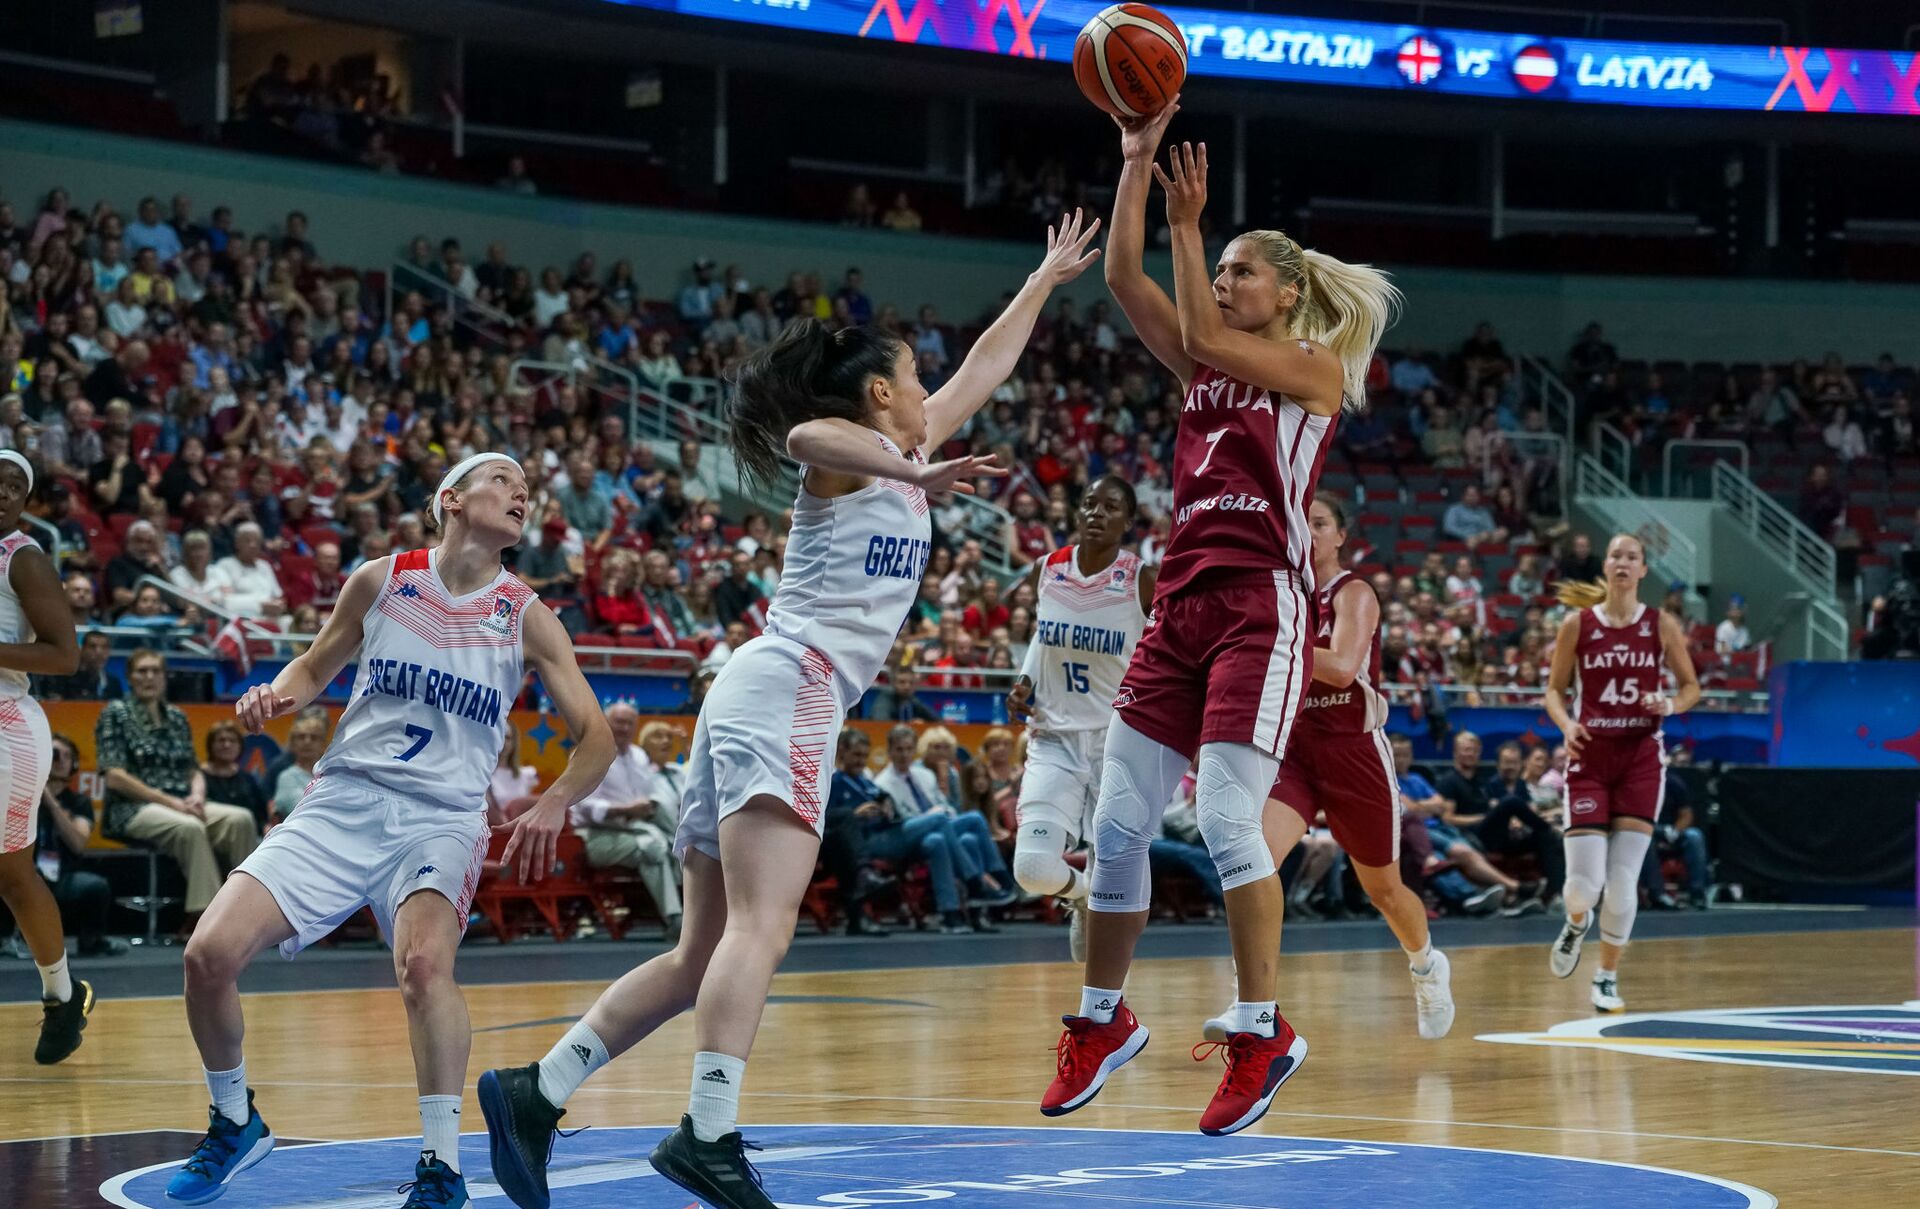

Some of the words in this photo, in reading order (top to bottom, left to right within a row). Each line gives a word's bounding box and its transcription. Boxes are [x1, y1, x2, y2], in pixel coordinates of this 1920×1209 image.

[1220, 25, 1374, 69] BRITAIN
[1455, 48, 1495, 77] VS
[1576, 52, 1714, 91] LATVIA
[1181, 382, 1274, 416] ATVIJA
[1194, 427, 1230, 478] 7
[1219, 493, 1270, 513] GĀZE
[864, 535, 920, 581] GREAT
[1038, 620, 1070, 648] REAT
[1072, 625, 1126, 657] BRITAIN
[1062, 662, 1090, 694] 15
[1584, 651, 1655, 670] LATVIJA
[424, 668, 502, 728] BRITAIN
[1599, 677, 1640, 706] 45
[393, 723, 434, 763] 7
